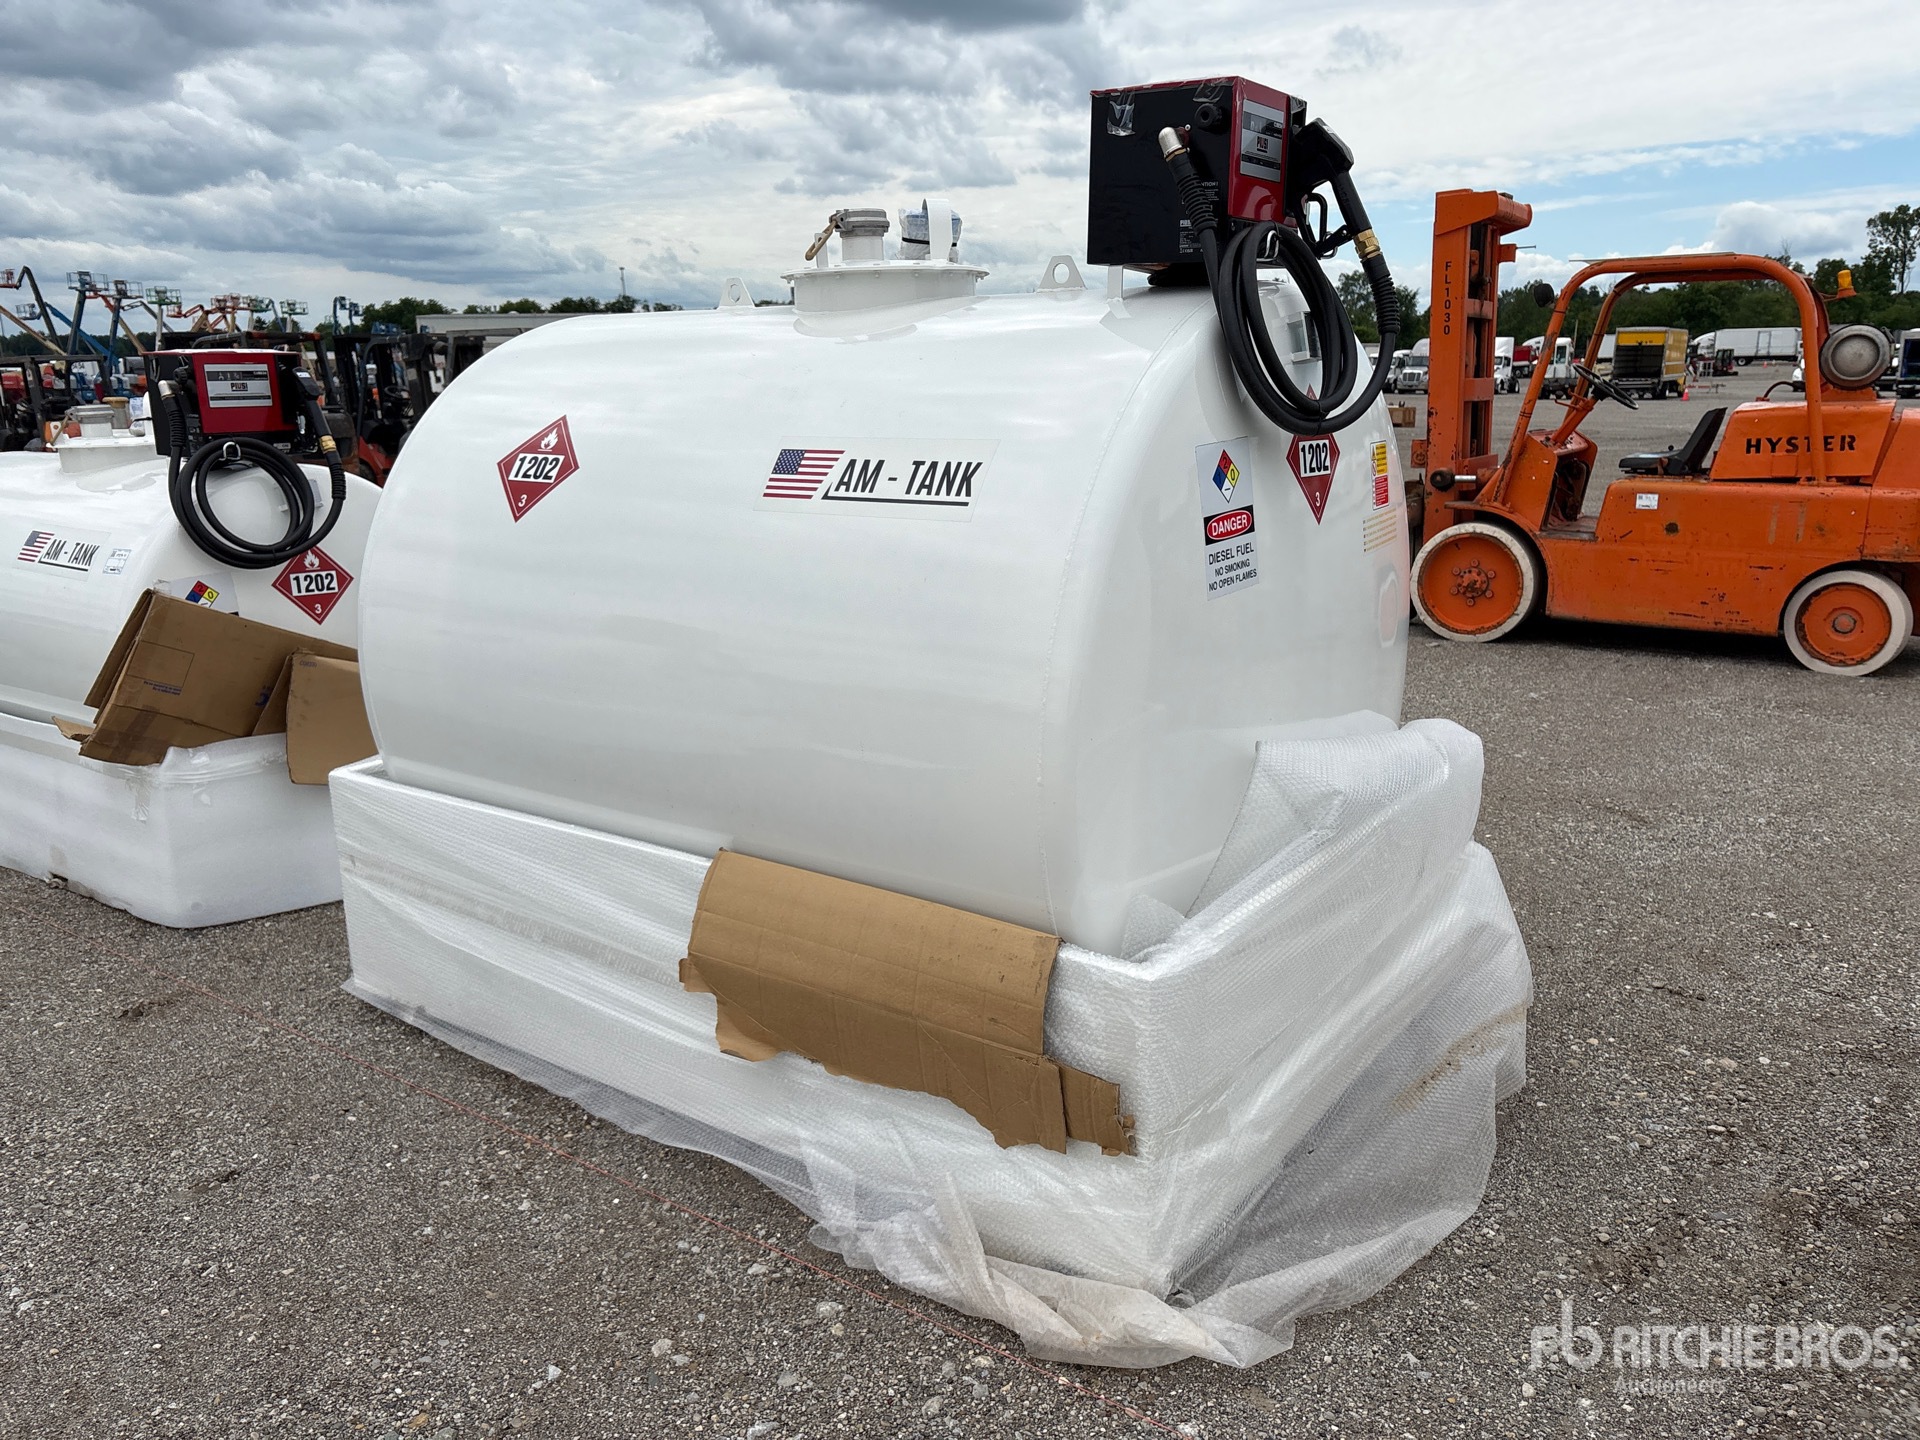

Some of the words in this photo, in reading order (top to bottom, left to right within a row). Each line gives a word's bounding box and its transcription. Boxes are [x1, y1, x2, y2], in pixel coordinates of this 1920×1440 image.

[1443, 261, 1452, 335] FL1030
[1746, 434, 1856, 454] HYSTER
[513, 455, 561, 481] 1202
[1222, 456, 1229, 470] 2
[1300, 442, 1329, 474] 1202
[834, 458, 885, 494] AM
[904, 460, 983, 498] TANK
[1230, 468, 1236, 481] 0
[518, 493, 528, 508] 3
[1315, 491, 1321, 507] 3
[1211, 514, 1248, 537] DANGER
[44, 539, 66, 561] AM
[67, 542, 100, 567] TANK
[1209, 547, 1234, 565] DIESEL
[1236, 542, 1254, 557] FUEL
[1215, 567, 1223, 577] NO
[1225, 559, 1250, 574] SMOKING
[292, 572, 336, 594] 1202
[1209, 582, 1217, 592] NO
[1219, 576, 1234, 588] OPEN
[1236, 569, 1257, 583] FLAMES
[207, 590, 214, 600] 0
[314, 603, 322, 614] 3
